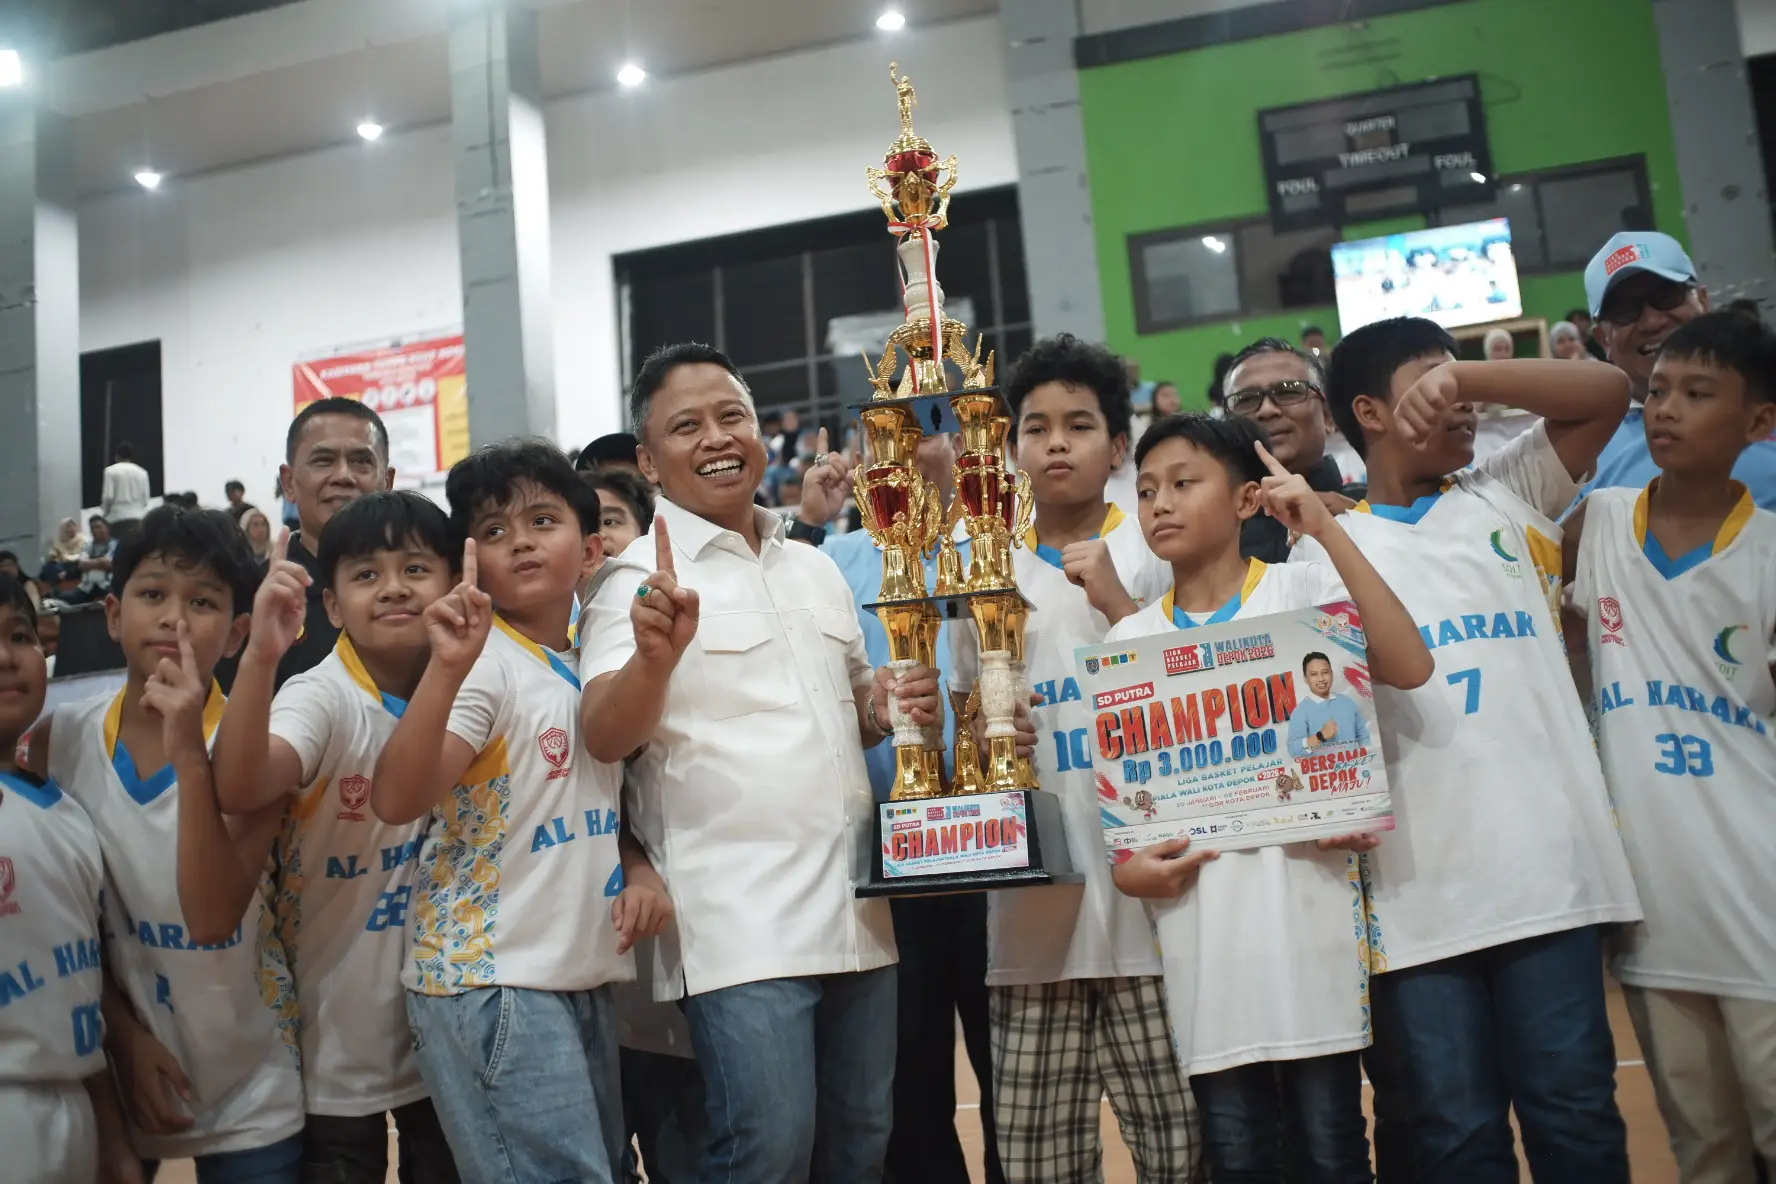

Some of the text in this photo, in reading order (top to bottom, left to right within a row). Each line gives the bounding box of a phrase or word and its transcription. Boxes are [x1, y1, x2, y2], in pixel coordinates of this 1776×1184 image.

[1345, 116, 1396, 136] QUARTER
[1338, 143, 1410, 169] TIMEOUT
[1434, 152, 1477, 170] FOUL
[1277, 178, 1320, 197] FOUL
[1215, 633, 1272, 652] WALIKOTA
[1216, 650, 1248, 666] DEPOK
[1249, 646, 1275, 660] 2026
[1097, 686, 1152, 706] SD PUTRA
[1446, 667, 1482, 716] 7
[1601, 681, 1635, 716] AL
[1095, 670, 1298, 760] CHAMPION
[1123, 728, 1278, 785] Rp 3.000.000
[1301, 747, 1368, 775] BERSAMA
[1654, 733, 1715, 778] 33
[1177, 758, 1283, 787] LIGA BASKET PELAJAR
[1309, 767, 1358, 793] DEPOK
[1152, 791, 1177, 802] PIALA
[1179, 787, 1201, 797] WALI
[1202, 782, 1225, 793] KOTA
[1226, 776, 1256, 788] DEPOK
[1187, 795, 1217, 806] JANUARI
[1234, 786, 1271, 796] FEBRUARI
[1225, 797, 1244, 806] KOTA
[1245, 792, 1271, 802] DEPOK
[530, 816, 576, 853] AL
[891, 815, 1018, 861] CHAMPION
[902, 821, 921, 829] PUTRA
[326, 854, 368, 879] AL
[0, 960, 46, 1009] AL
